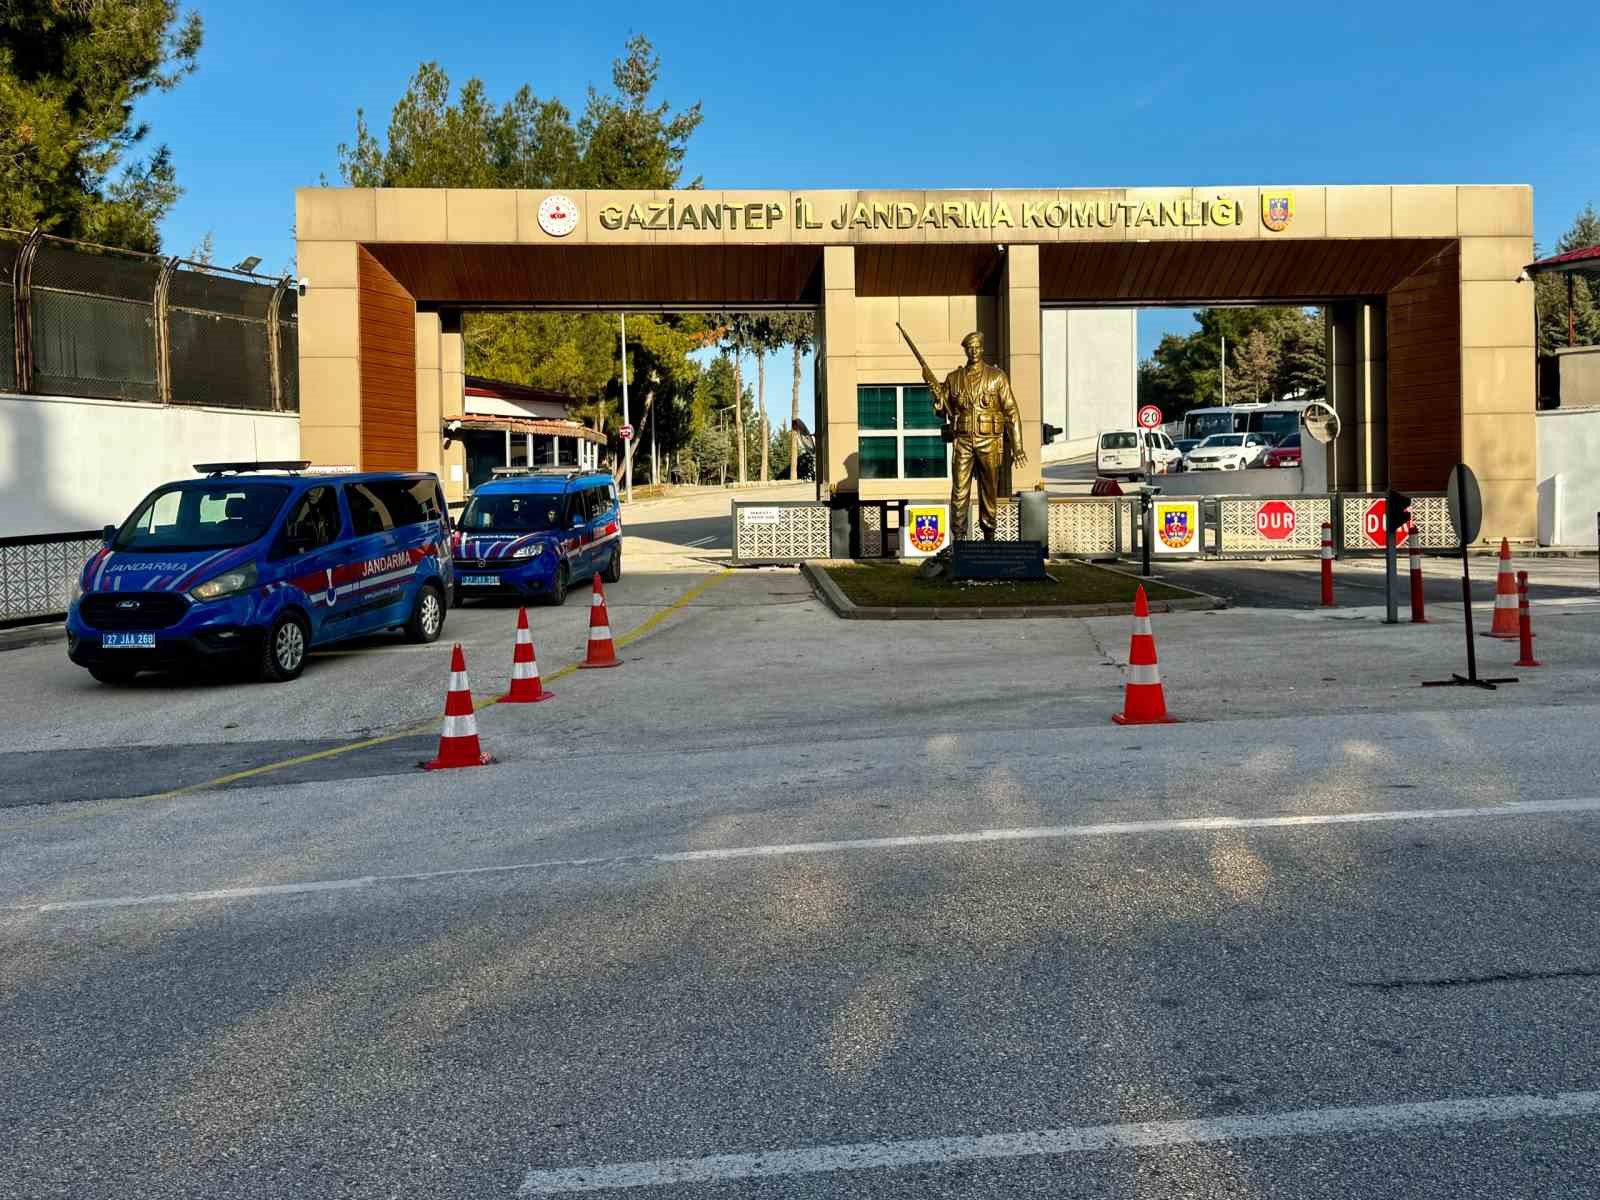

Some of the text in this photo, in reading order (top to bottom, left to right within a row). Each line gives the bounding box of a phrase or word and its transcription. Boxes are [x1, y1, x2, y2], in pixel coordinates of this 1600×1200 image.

[600, 198, 783, 230] GAZİANTEP
[796, 198, 823, 229] İL
[831, 201, 1014, 229] JANDARMA
[1022, 194, 1244, 228] KOMUTANLIĞI
[1143, 410, 1157, 423] 20
[1258, 512, 1294, 529] DUR
[105, 560, 187, 573] JANDARMA
[362, 551, 411, 577] JANDARMA
[106, 634, 117, 644] 27
